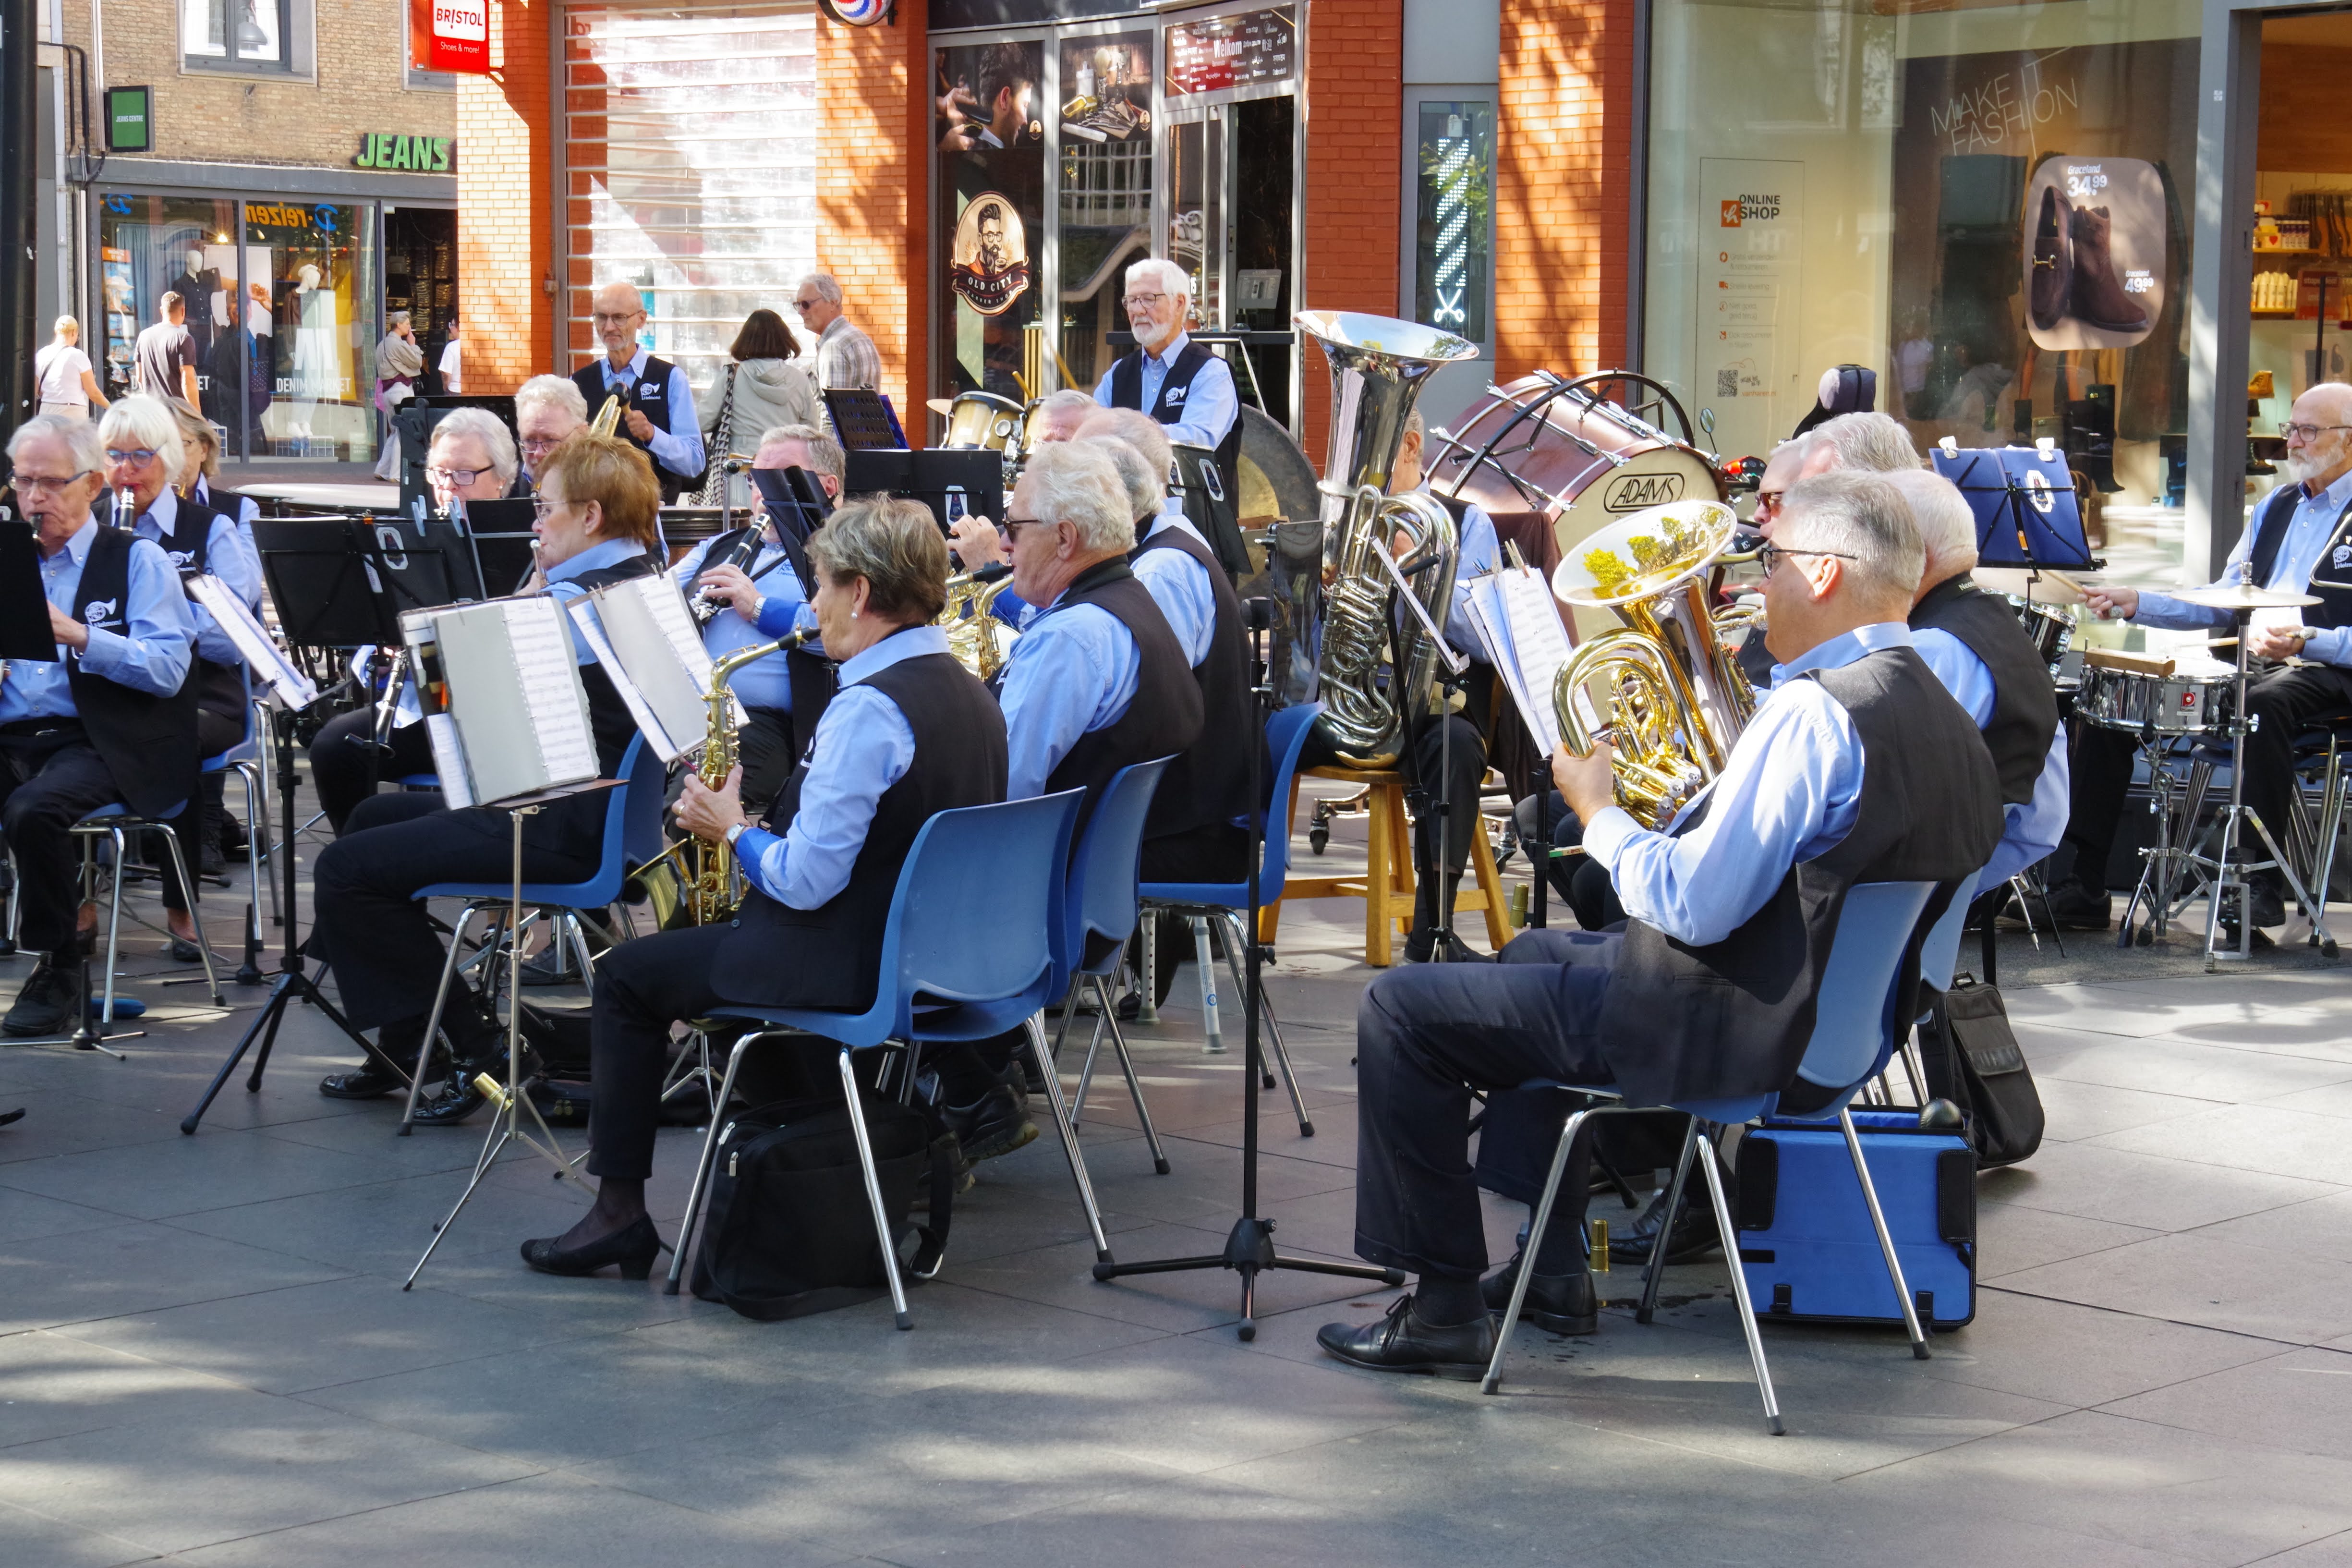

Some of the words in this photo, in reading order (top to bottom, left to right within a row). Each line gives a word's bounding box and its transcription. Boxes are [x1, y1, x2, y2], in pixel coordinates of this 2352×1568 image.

[440, 41, 457, 51] Shoes
[458, 43, 462, 52] &
[1213, 38, 1242, 58] Welkom
[1931, 73, 2013, 136] MAKE
[2021, 46, 2073, 98] IT
[1951, 77, 2078, 160] FASHION
[357, 133, 449, 171] JEANS
[2068, 165, 2101, 174] Graceland
[1739, 194, 1780, 205] ONLINE
[1740, 207, 1780, 219] SHOP
[968, 277, 985, 291] OLD
[991, 273, 1012, 292] CITY
[967, 290, 992, 304] BARBER
[277, 377, 307, 392] DENIM
[311, 377, 351, 392] MARKET
[1611, 477, 1675, 508] ADAMS
